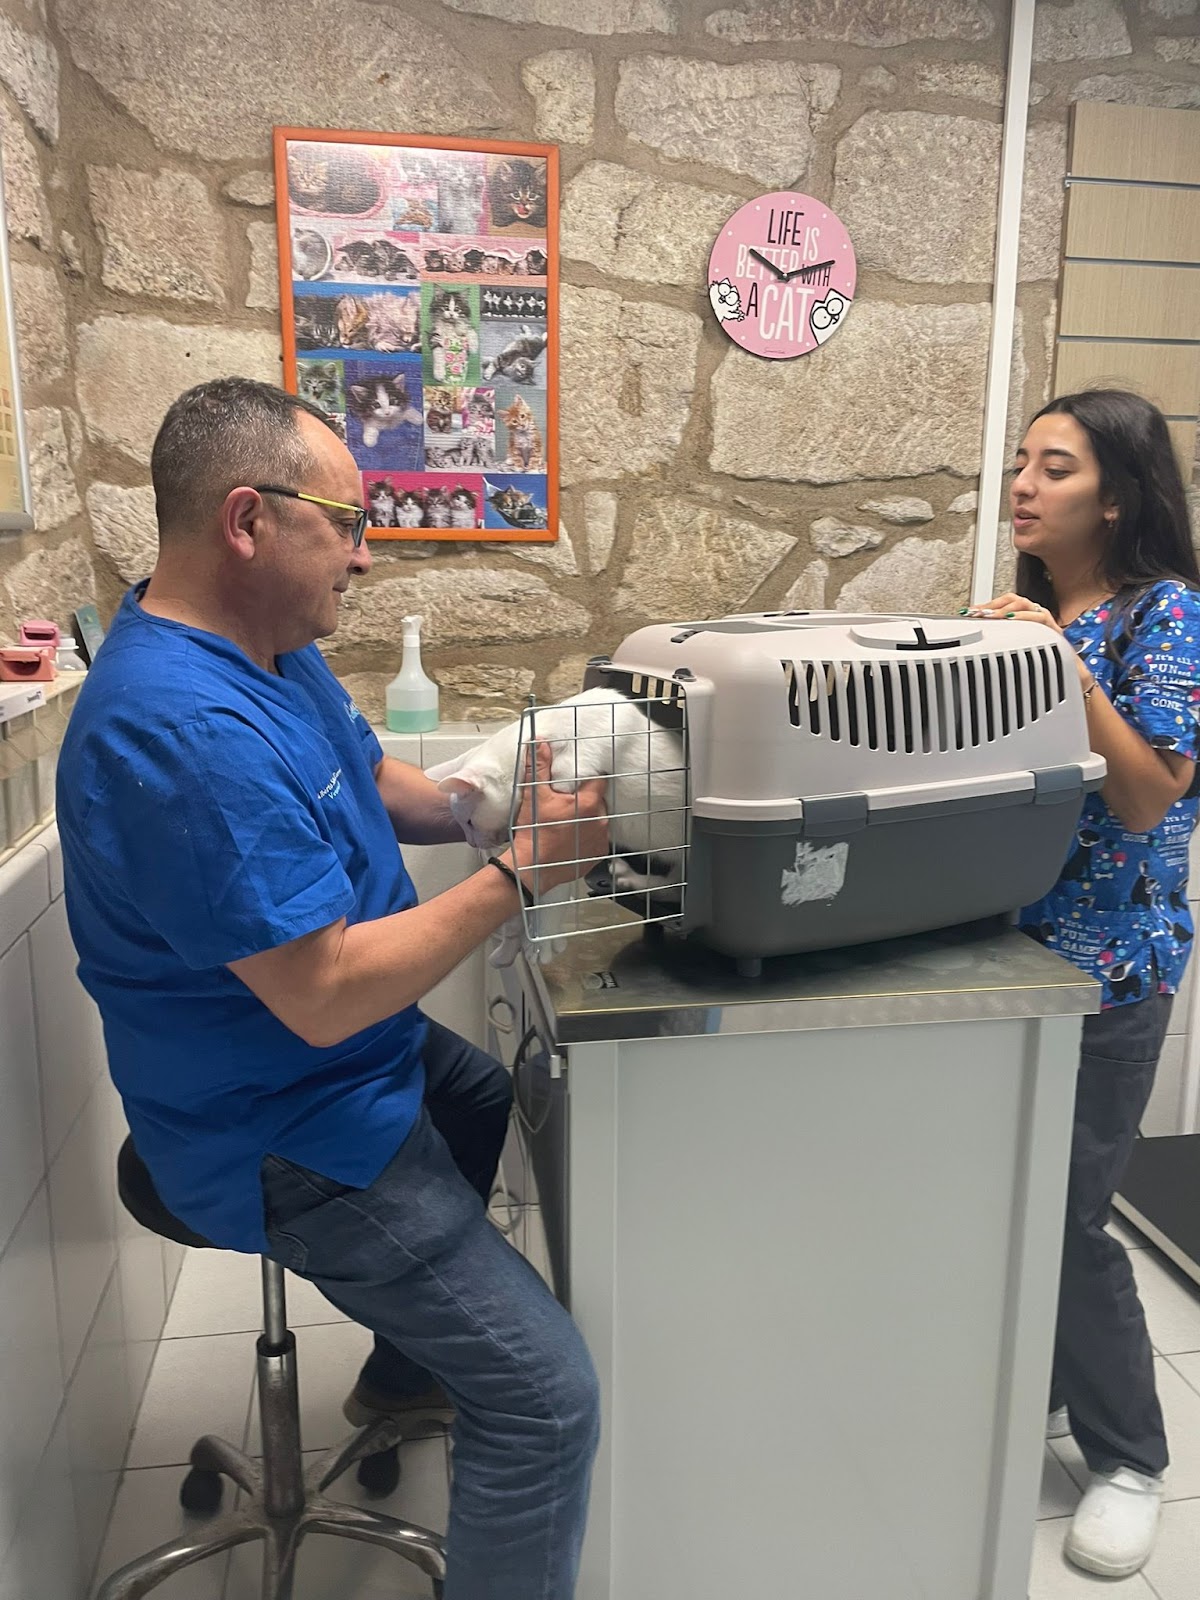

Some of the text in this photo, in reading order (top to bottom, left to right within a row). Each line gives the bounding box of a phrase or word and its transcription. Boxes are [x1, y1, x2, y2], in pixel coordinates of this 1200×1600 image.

[767, 208, 820, 262] LIFE IS
[735, 243, 831, 288] BETTER WITH
[745, 282, 815, 343] A CAT
[1149, 663, 1178, 675] FUN
